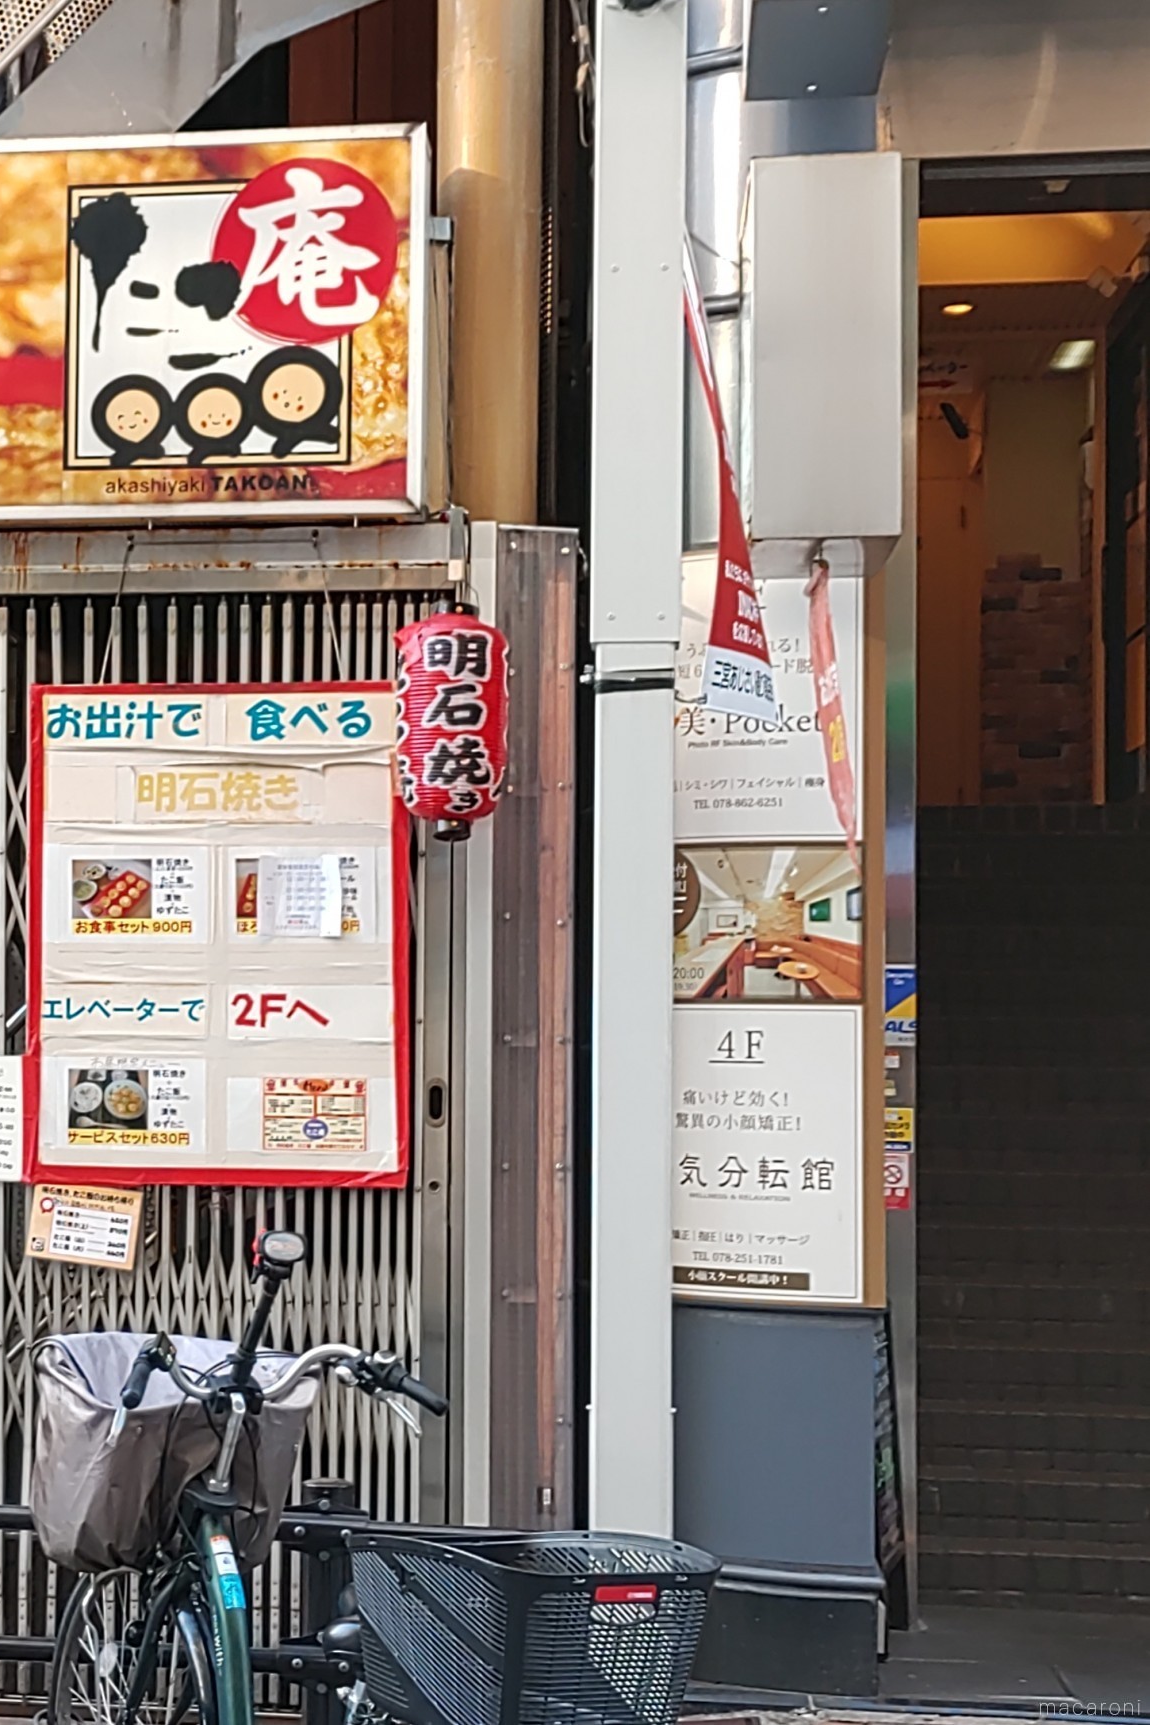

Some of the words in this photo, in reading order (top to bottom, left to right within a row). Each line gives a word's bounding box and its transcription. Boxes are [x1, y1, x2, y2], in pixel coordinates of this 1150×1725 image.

[105, 475, 205, 500] akashiyaki
[211, 474, 308, 492] TAKOAN
[47, 701, 203, 740] お出汁で
[246, 699, 372, 741] 食べる
[424, 631, 492, 812] 明石焼き
[137, 772, 299, 813] 明石焼き
[693, 799, 710, 810] TEL
[42, 997, 205, 1022] エレベーターで
[232, 993, 330, 1028] 2Fへ
[679, 1153, 834, 1190] 気分転館
[692, 1251, 710, 1262] TEL
[712, 1252, 783, 1265] 078-251-1781
